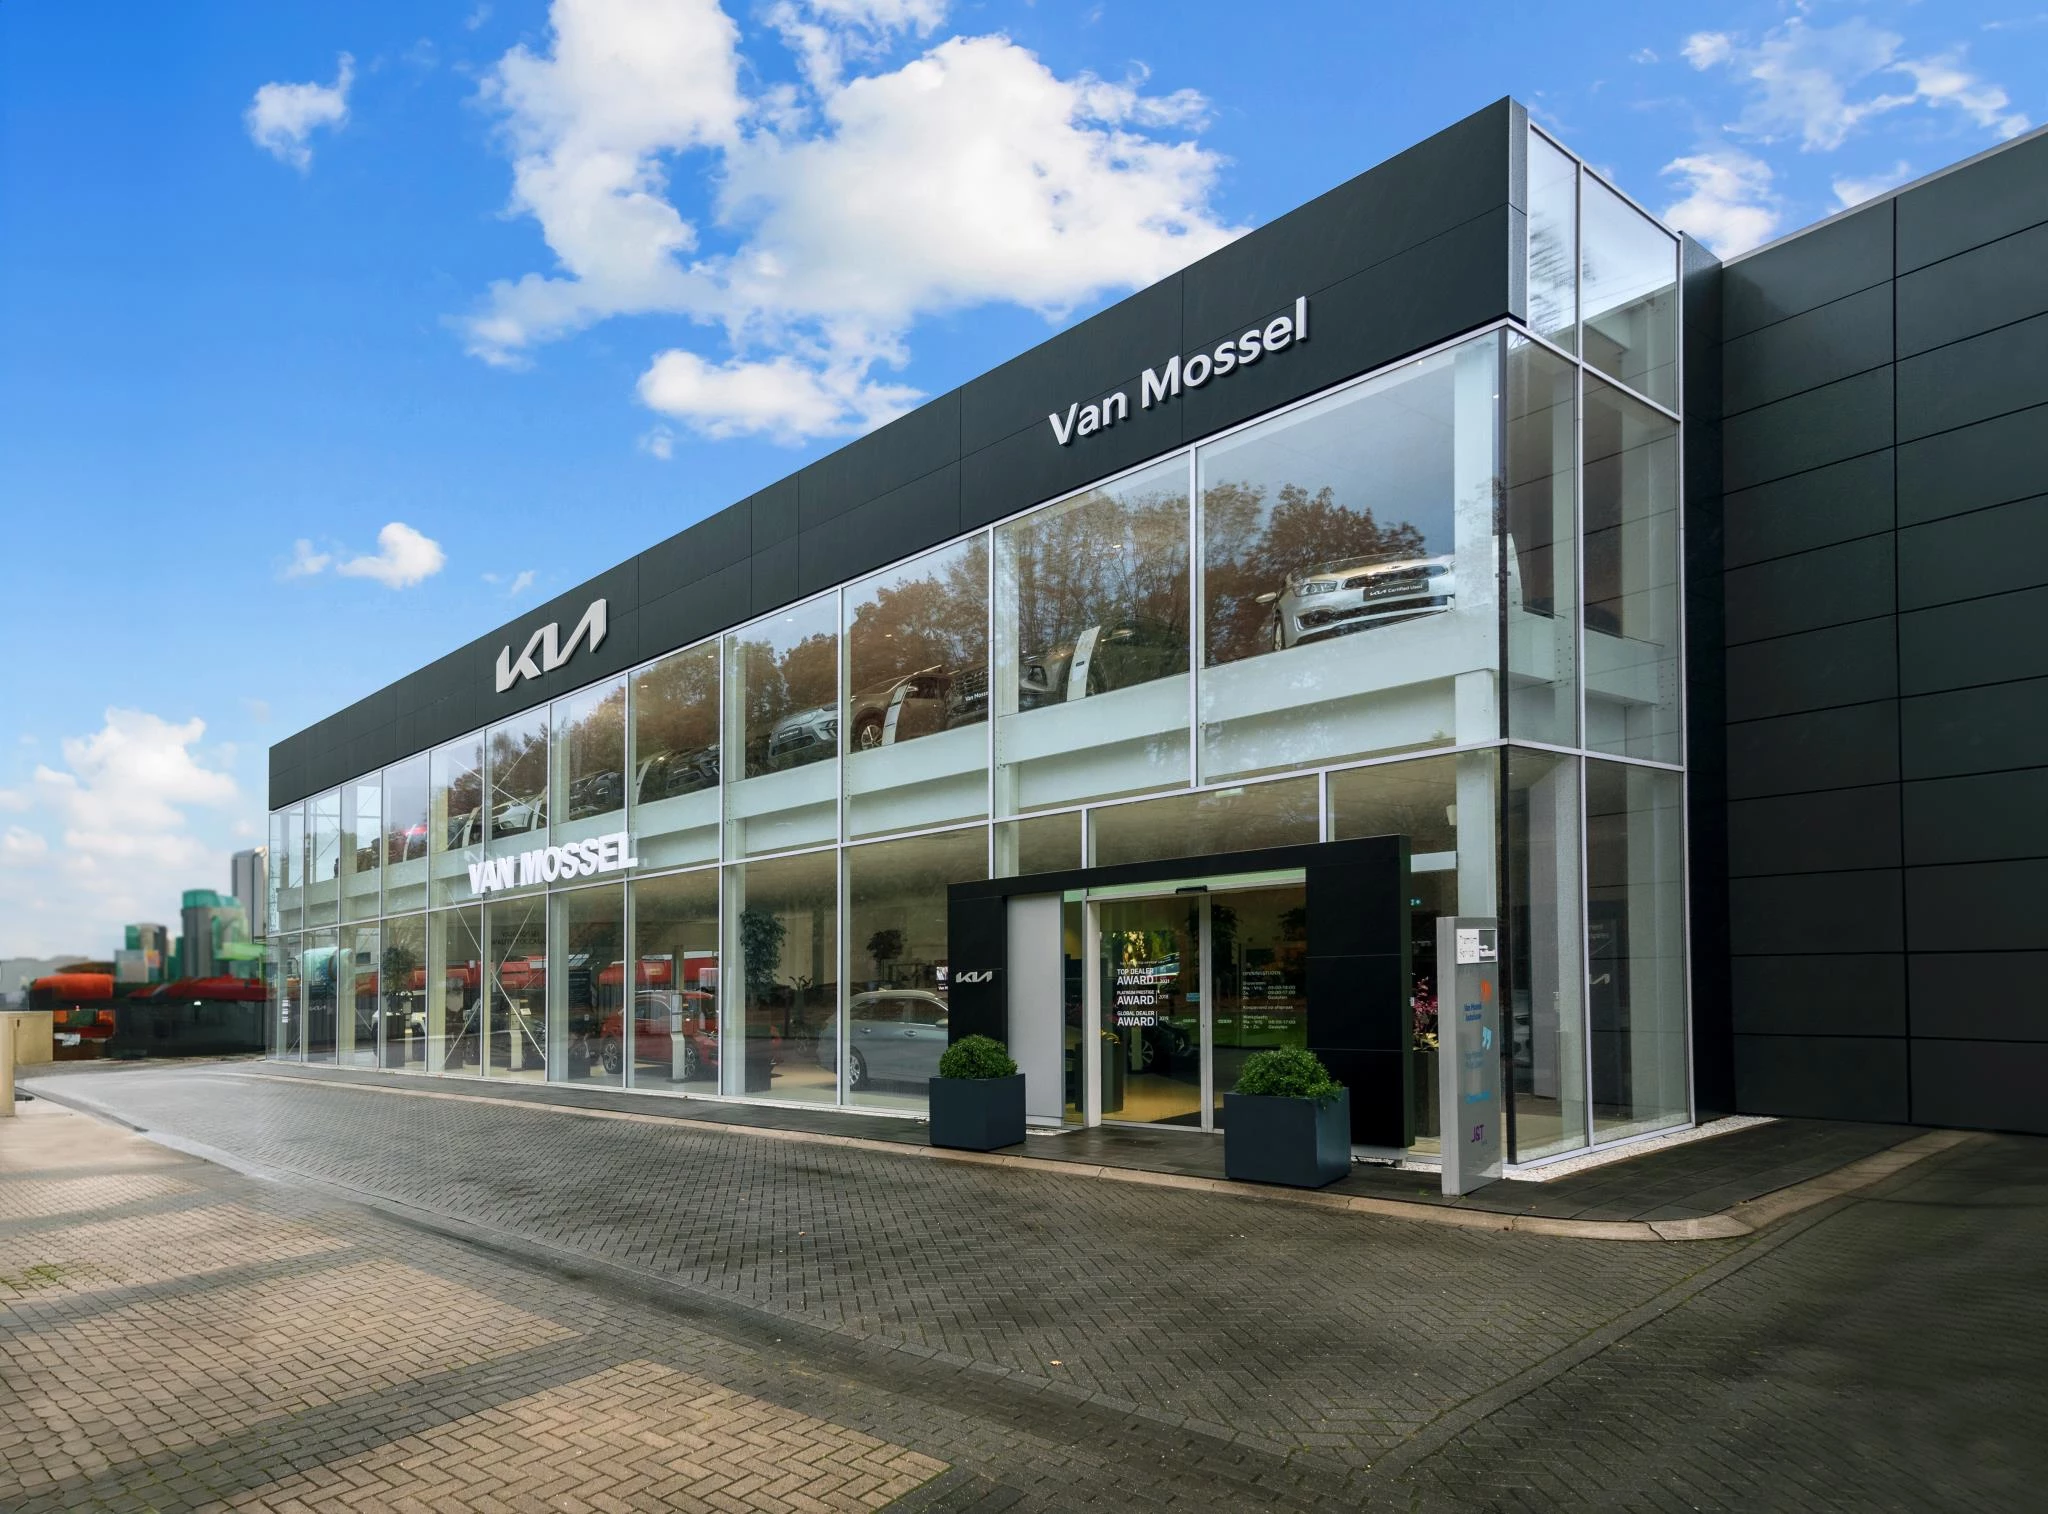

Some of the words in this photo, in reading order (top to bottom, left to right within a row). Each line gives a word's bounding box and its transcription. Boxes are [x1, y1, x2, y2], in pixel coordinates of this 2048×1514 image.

[1049, 402, 1128, 446] Van
[1142, 296, 1307, 408] Mossel
[496, 598, 607, 693] KIA
[468, 855, 515, 895] VAN
[521, 832, 638, 887] MOSSEL
[956, 970, 993, 983] KIA
[1130, 967, 1154, 975] DEALER
[1117, 975, 1154, 985] AWARD
[1117, 995, 1154, 1005] AWARD
[1117, 1017, 1155, 1026] AWARD
